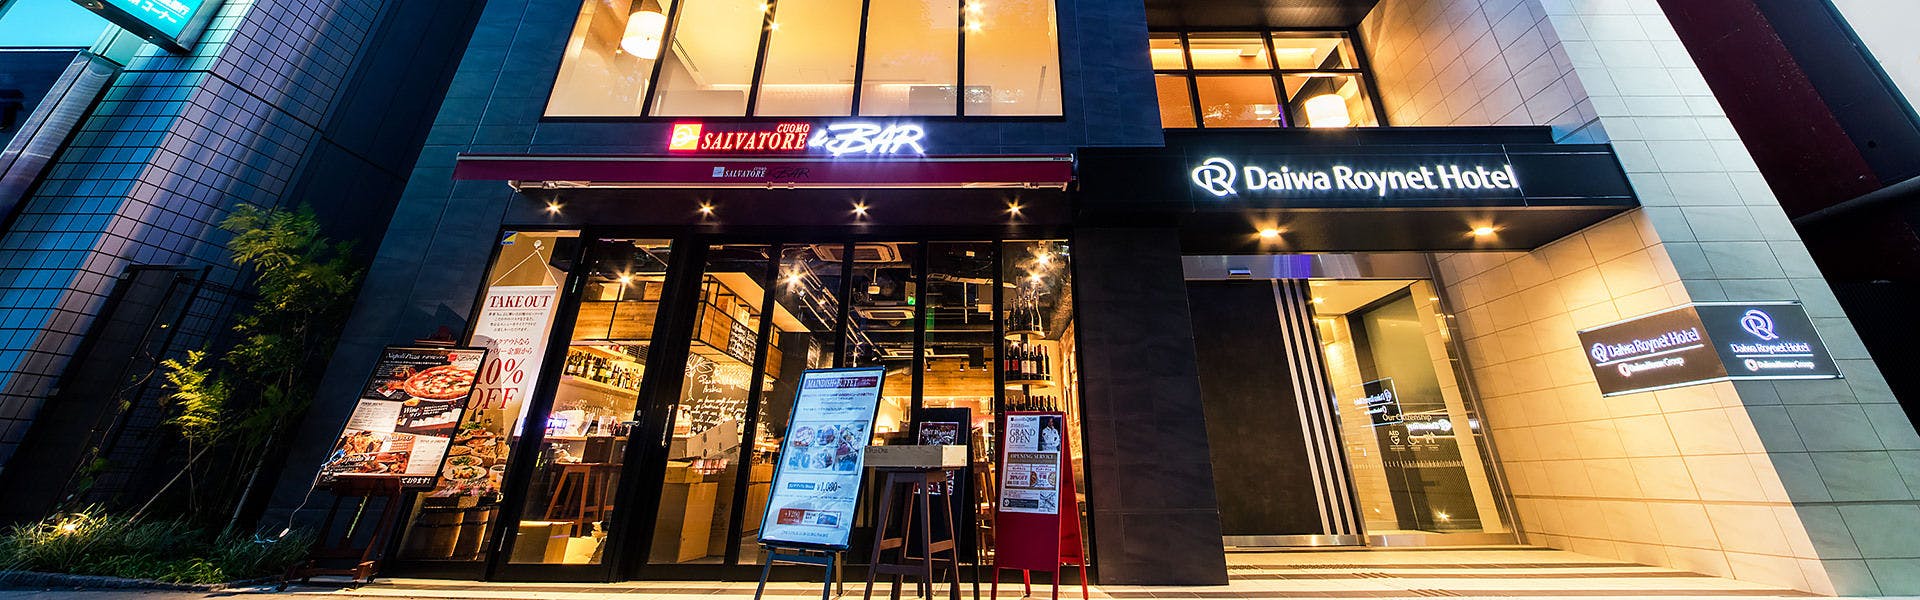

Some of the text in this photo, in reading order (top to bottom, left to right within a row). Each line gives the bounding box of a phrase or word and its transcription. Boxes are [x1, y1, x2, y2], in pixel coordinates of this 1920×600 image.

[776, 123, 811, 133] CUOMO
[701, 132, 808, 151] SALVATORE
[826, 123, 926, 158] BAR
[724, 170, 766, 178] SALVATORE
[1243, 165, 1333, 191] Daiwa
[1332, 165, 1436, 197] Roynet
[1437, 164, 1519, 189] Hotel
[489, 295, 551, 308] TAKE OUT
[1606, 341, 1636, 357] Daiwa
[1635, 335, 1670, 354] Roynet
[1670, 328, 1700, 345] Hotel
[1731, 343, 1811, 355] Daiwa Roynet Hotel
[467, 387, 519, 410] OFF
[1382, 413, 1395, 422] Our
[1009, 428, 1036, 437] GRAND
[1009, 435, 1030, 444] OPEN
